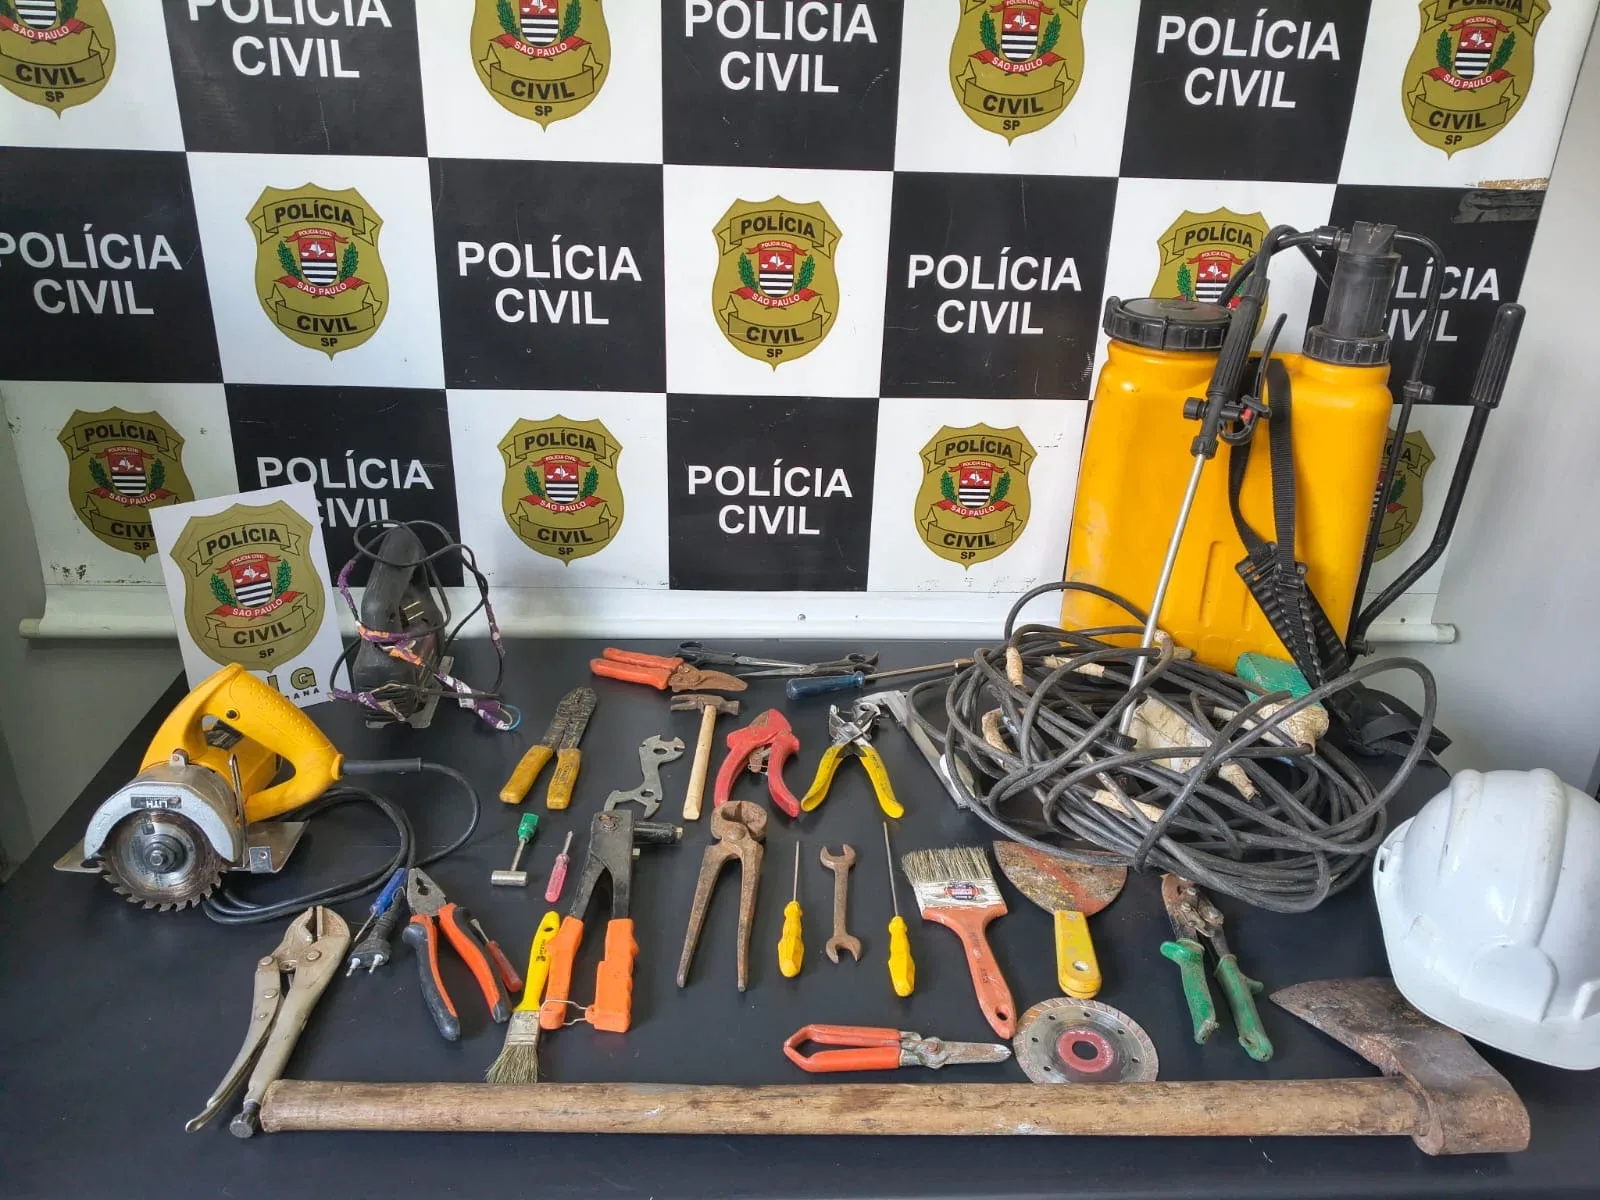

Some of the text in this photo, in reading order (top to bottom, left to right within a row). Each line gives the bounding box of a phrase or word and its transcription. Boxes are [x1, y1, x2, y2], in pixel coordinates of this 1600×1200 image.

[38, 25, 69, 40] PAULO
[1156, 8, 1340, 60] POLÍCIA
[232, 35, 360, 78] CIVIL
[538, 42, 568, 56] PAULO
[16, 63, 85, 85] CIVIL
[720, 51, 839, 93] CIVIL
[1013, 58, 1043, 72] PAULO
[511, 80, 575, 100] CIVIL
[1184, 67, 1296, 108] CIVIL
[1462, 75, 1493, 89] PAULO
[45, 91, 64, 103] SP
[983, 95, 1044, 115] CIVIL
[534, 105, 553, 116] SP
[1428, 110, 1487, 130] CIVIL
[1002, 120, 1020, 130] SP
[1444, 135, 1462, 145] SP
[274, 200, 356, 226] POLÍCIA
[740, 212, 816, 238] POLÍCIA
[1184, 223, 1253, 248] POLÍCIA
[0, 223, 183, 270] POLÍCIA
[457, 234, 642, 282] POLÍCIA
[907, 246, 1082, 291] POLÍCIA
[319, 282, 347, 296] PAULO
[1393, 257, 1500, 301] LÍCIA
[33, 278, 155, 315] CIVIL
[495, 287, 609, 325] CIVIL
[772, 294, 801, 307] PAULO
[296, 315, 358, 333] CIVIL
[936, 299, 1044, 335] CIVIL
[321, 338, 338, 347] SP
[746, 326, 804, 344] CIVIL
[766, 348, 783, 358] SP
[84, 421, 159, 444] POLÍCIA
[524, 429, 597, 452] POLÍCIA
[944, 437, 1014, 458] POLÍCIA
[256, 449, 434, 490] POLÍCIA
[688, 458, 853, 498] POLÍCIA
[130, 494, 157, 505] PAULO
[559, 501, 587, 512] PAULO
[718, 504, 821, 535] CIVIL
[969, 505, 995, 517] PAULO
[111, 522, 155, 538] CIVI
[537, 528, 593, 544] CIVIL
[943, 532, 996, 548] CIVIL
[134, 541, 150, 551] SP
[206, 527, 281, 555] POLÍCIA
[558, 546, 574, 556] SP
[960, 551, 976, 560] SP
[254, 598, 283, 617] PAULO
[233, 621, 292, 646] CIVIL
[259, 648, 275, 659] SP
[267, 666, 317, 693] IG
